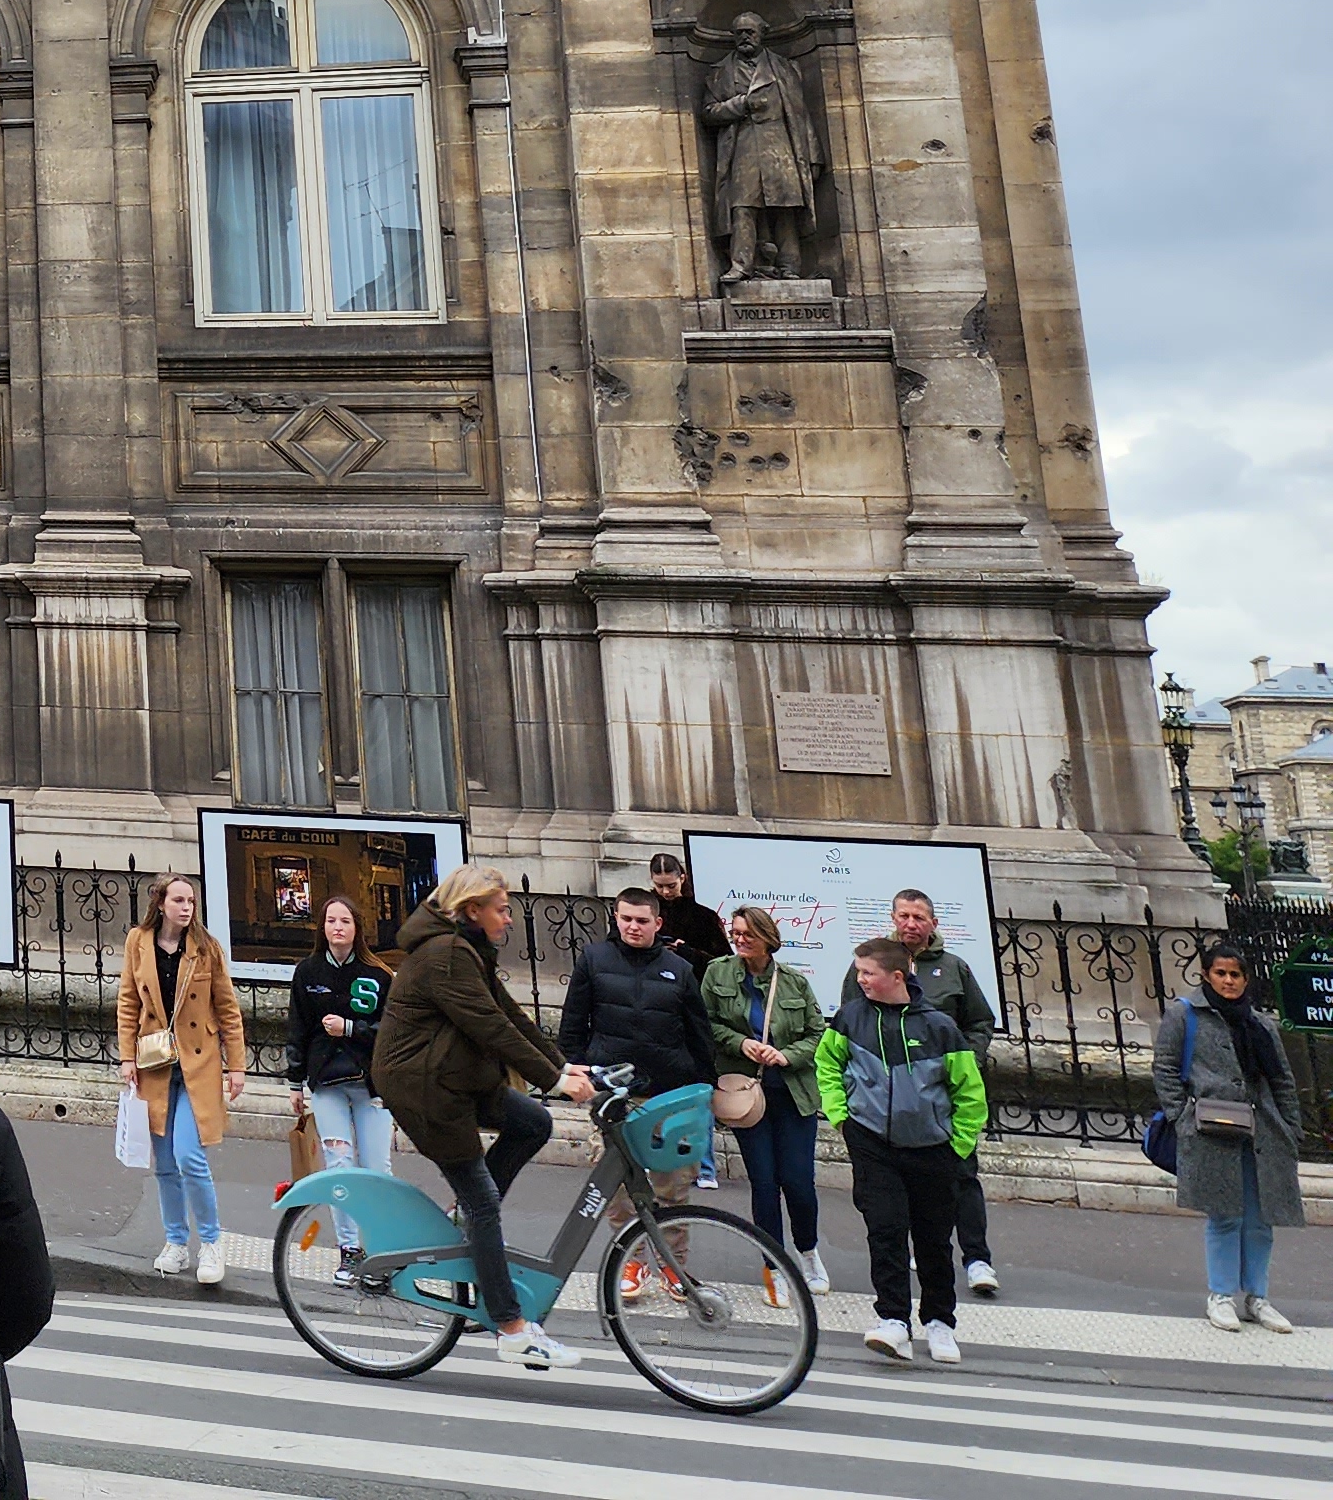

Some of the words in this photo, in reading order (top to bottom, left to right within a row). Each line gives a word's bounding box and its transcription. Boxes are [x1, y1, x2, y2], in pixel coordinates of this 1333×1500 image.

[281, 831, 296, 842] du
[300, 832, 336, 844] COIN
[821, 866, 851, 875] PARIS
[726, 889, 744, 899] Au
[747, 890, 796, 902] bonheur
[798, 893, 818, 903] des
[350, 977, 380, 1015] S
